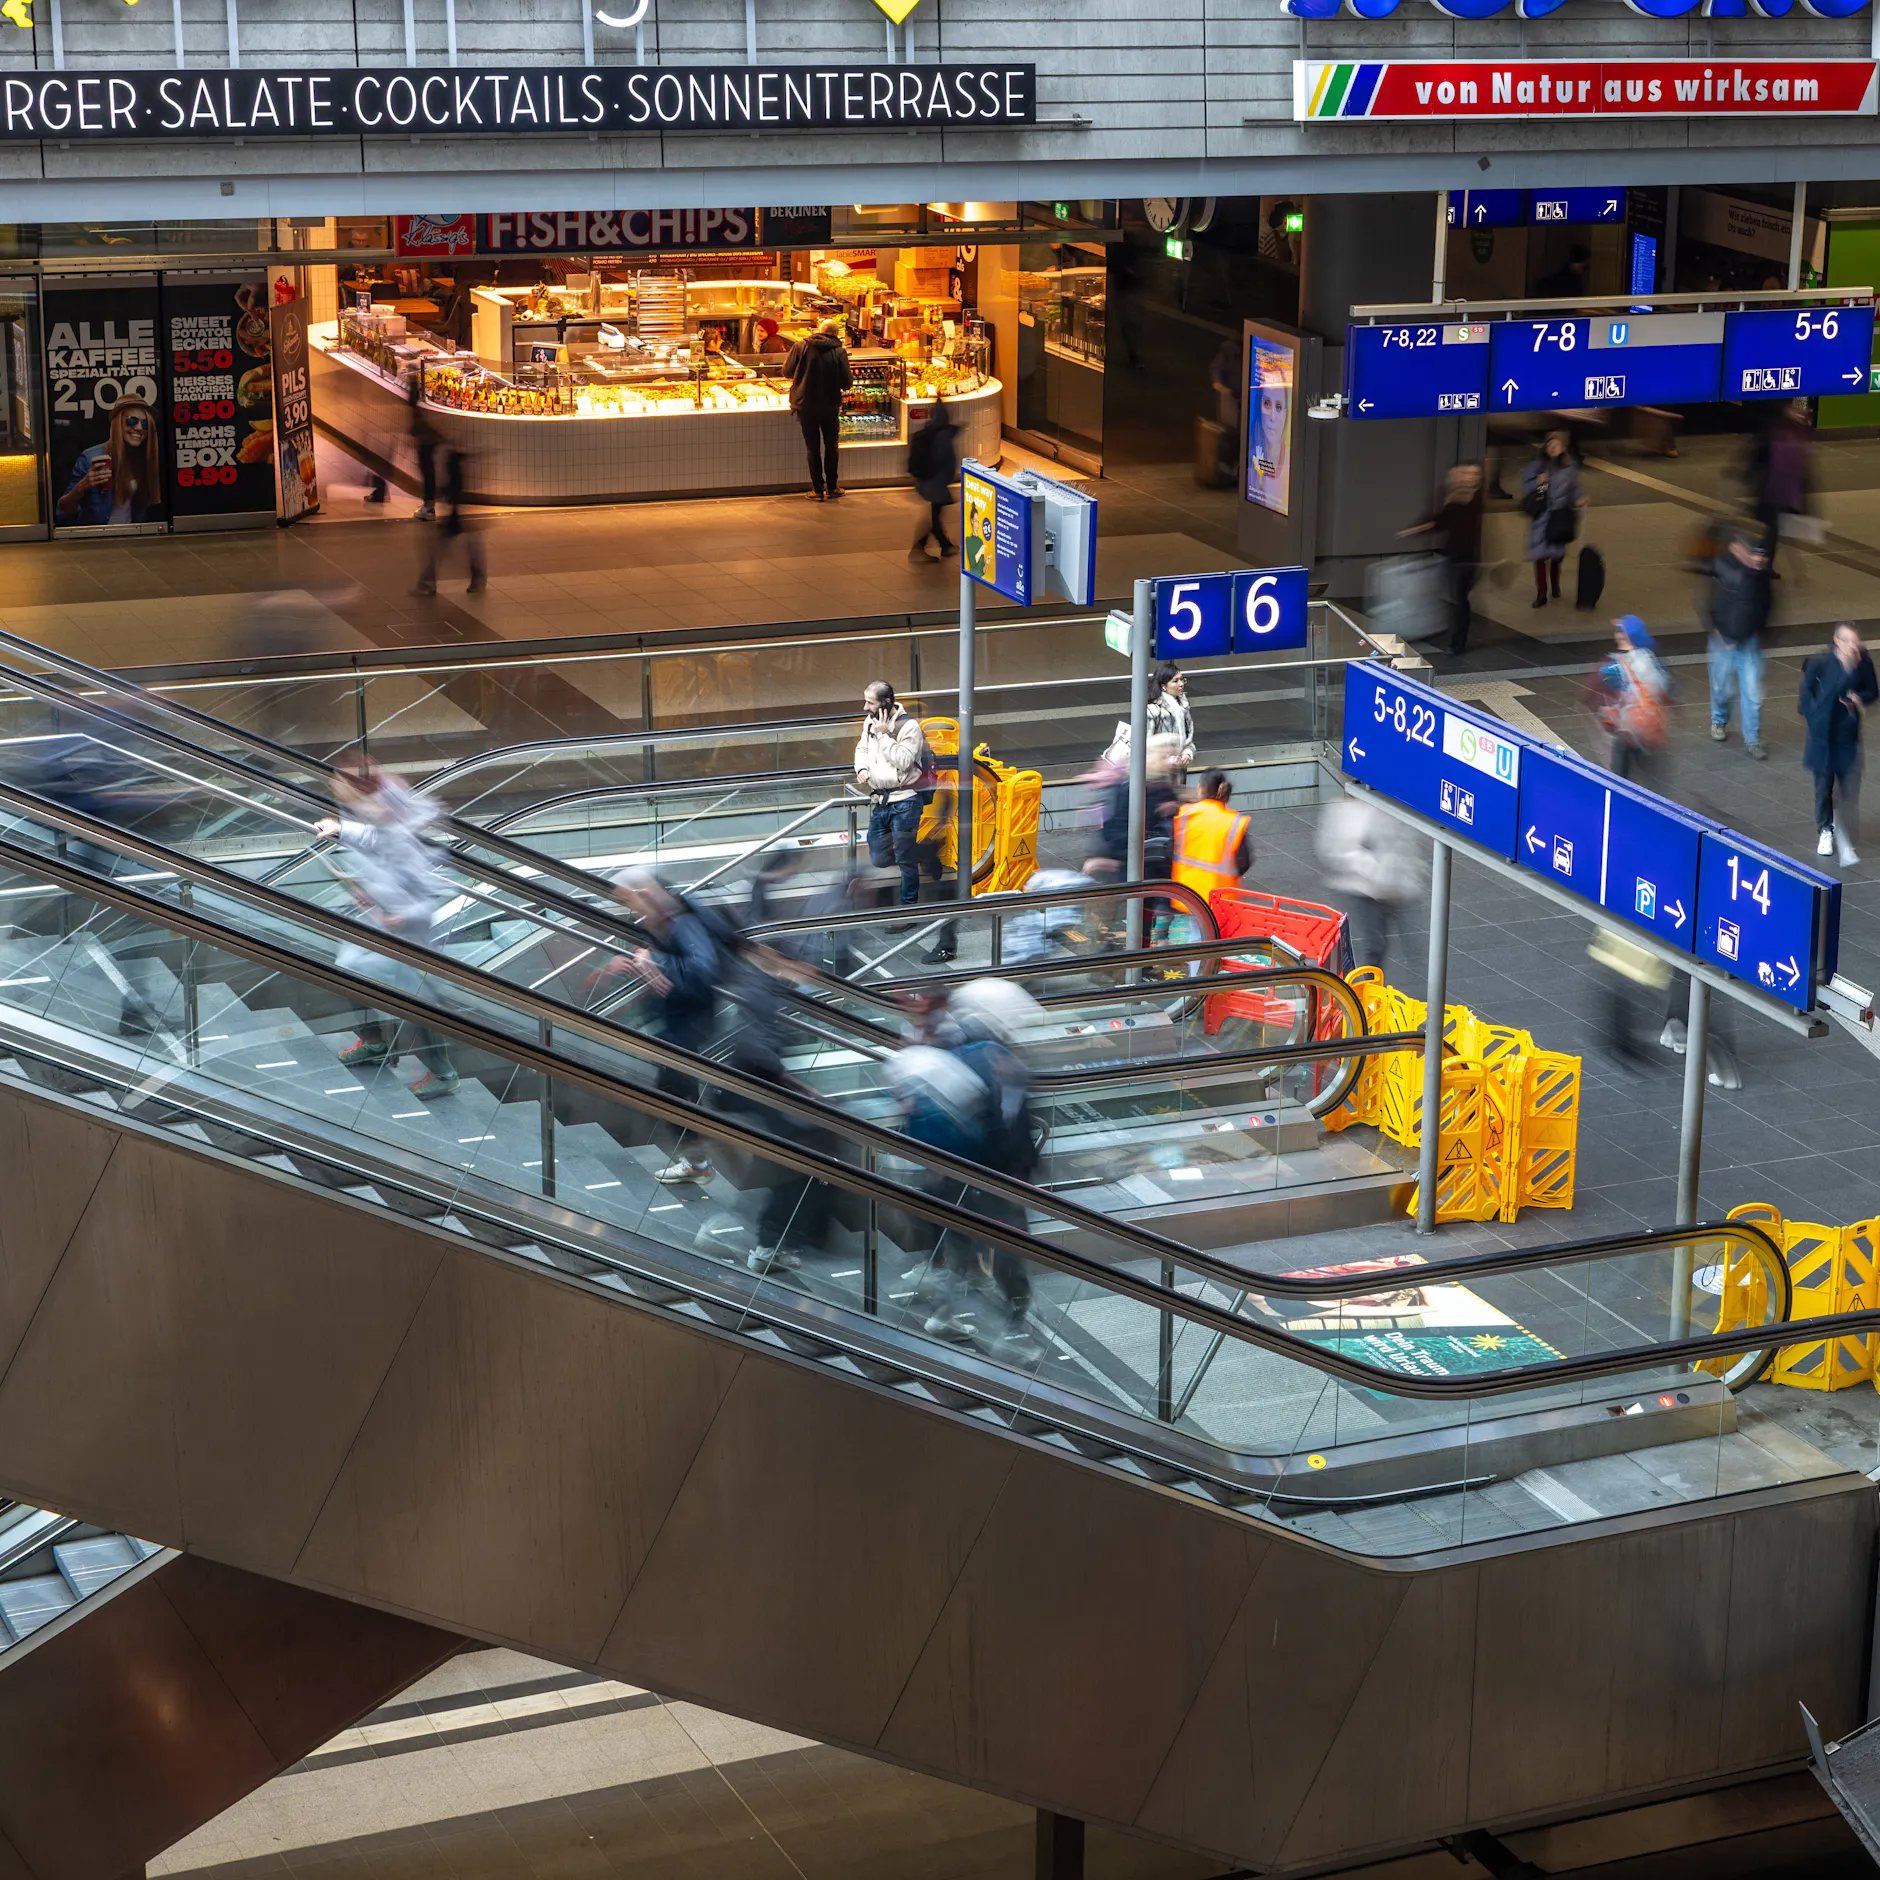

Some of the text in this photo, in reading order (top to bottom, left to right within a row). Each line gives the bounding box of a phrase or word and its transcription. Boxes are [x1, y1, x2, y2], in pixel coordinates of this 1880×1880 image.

[1415, 69, 1820, 105] von Natur aus wirksam
[160, 76, 333, 129] SALATE
[354, 74, 604, 125] COCKTAILS
[628, 71, 1026, 122] SONNENTERRASSE
[171, 316, 231, 329] SWEET
[172, 328, 232, 338] POTATOE
[1794, 310, 1839, 341] 5-6
[47, 320, 154, 350] ALLE
[172, 337, 232, 351] ECKEN
[1382, 328, 1437, 350] 7-8,22
[1532, 322, 1627, 353] 7-8 U
[48, 346, 156, 369] KAFFEE
[174, 349, 233, 372] 5.50
[49, 364, 156, 380] SPEZIALITÄTEN
[173, 374, 234, 388] HEISSES
[281, 367, 306, 397] PILS
[54, 376, 157, 419] 2,00
[174, 385, 234, 394] BACKFISCH
[174, 392, 234, 402] BAGUETTE
[173, 400, 236, 424] 6.90
[284, 400, 308, 429] 3,90
[175, 425, 237, 441] LACHS
[176, 438, 236, 448] TEMPURA
[176, 446, 237, 469] BOX
[178, 466, 238, 487] 6.90
[965, 476, 981, 492] best
[980, 486, 993, 502] way
[965, 491, 974, 504] to
[1168, 582, 1202, 641] 5
[1246, 575, 1280, 634] 6
[1373, 686, 1436, 749] 5-8,22
[1498, 747, 1511, 777] U
[1727, 855, 1772, 916] 1-4
